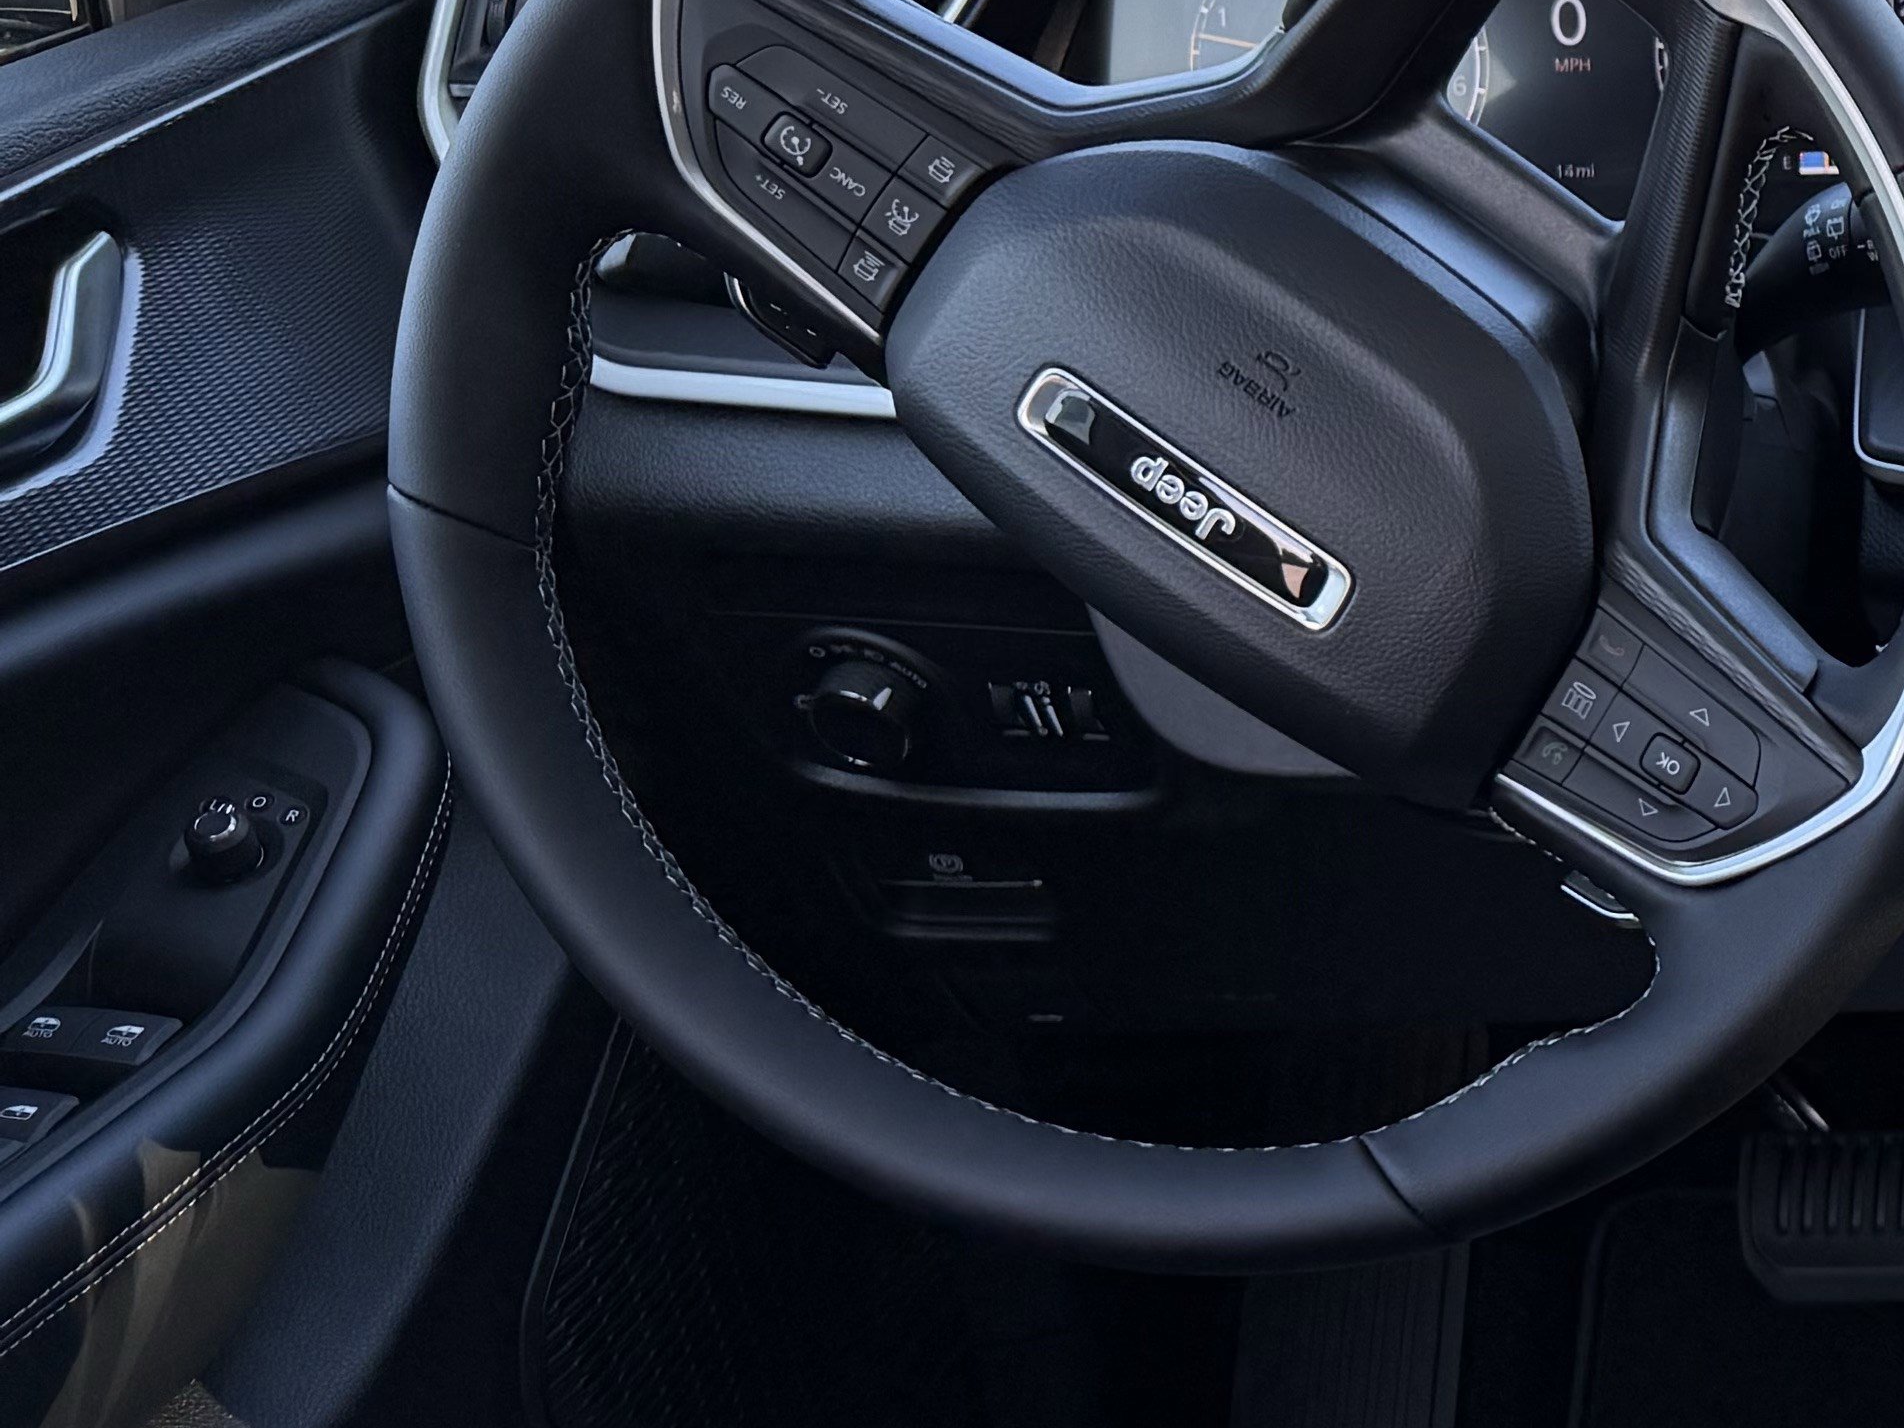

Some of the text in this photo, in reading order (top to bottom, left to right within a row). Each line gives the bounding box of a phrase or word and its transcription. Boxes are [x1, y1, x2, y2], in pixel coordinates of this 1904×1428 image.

[1218, 7, 1226, 27] 1
[1554, 57, 1592, 72] MPH
[720, 85, 747, 110] RES
[1452, 75, 1468, 97] 6
[829, 166, 866, 197] CANC
[1216, 360, 1296, 418] AIRBAG
[1129, 454, 1237, 540] Jeep
[1655, 751, 1681, 776] OK
[285, 809, 300, 822] R
